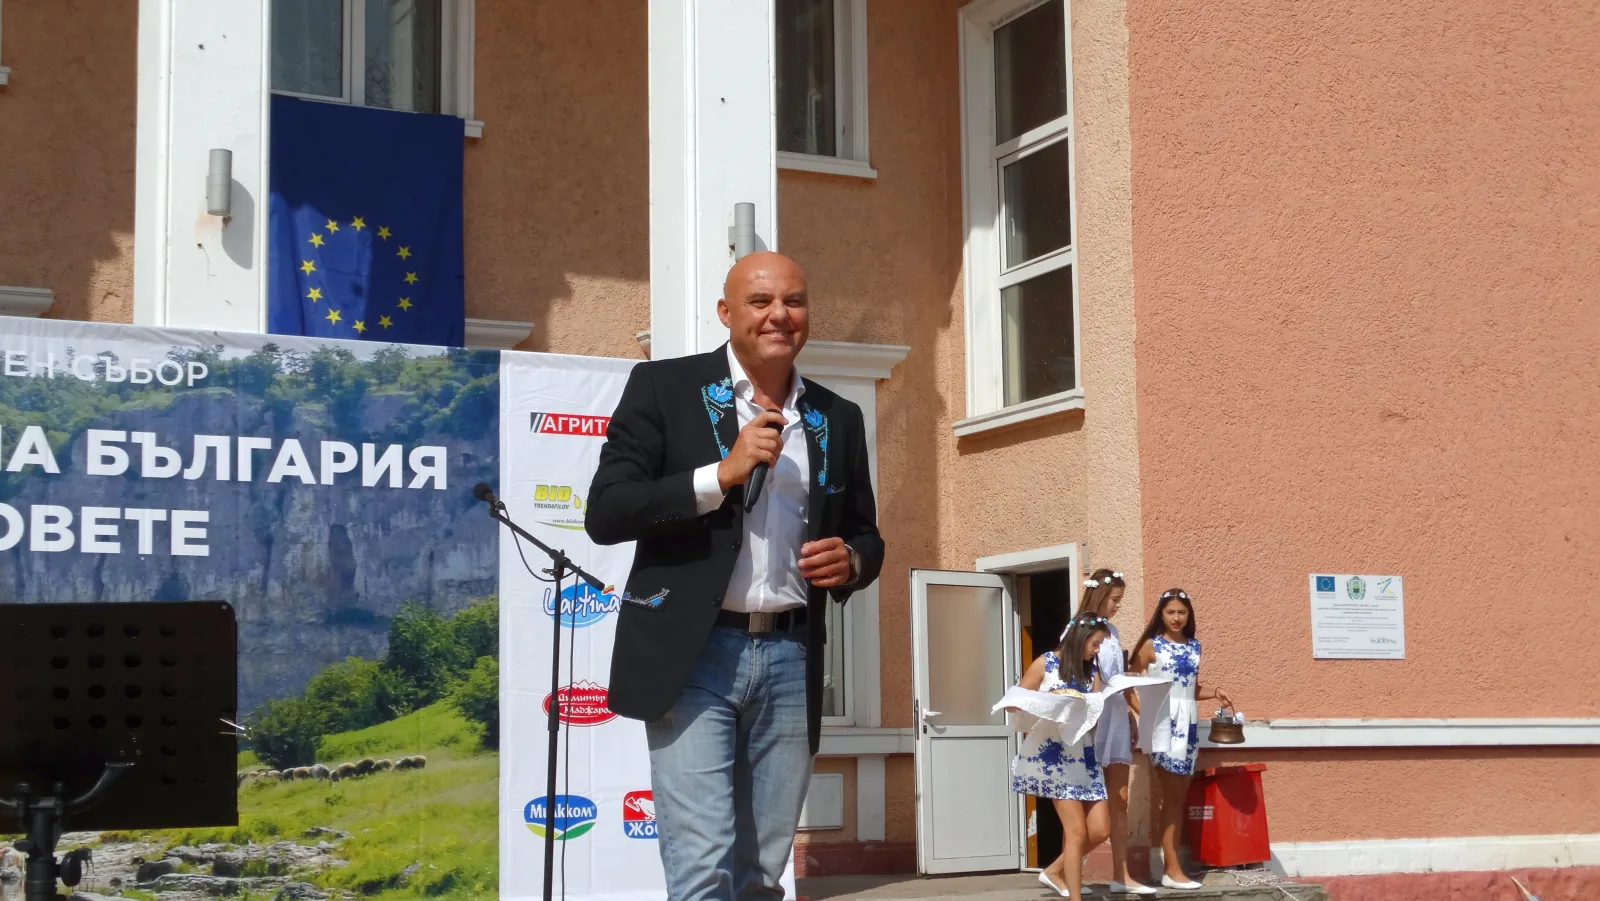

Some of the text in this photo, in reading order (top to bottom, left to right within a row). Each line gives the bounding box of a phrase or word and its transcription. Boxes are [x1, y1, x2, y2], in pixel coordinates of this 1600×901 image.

[4, 349, 209, 387] ЕН СЪБОР
[543, 416, 610, 434] АГРИТ
[0, 425, 448, 490] А БЪЛГАРИЯ
[534, 484, 572, 502] BIO
[543, 584, 622, 618] Lactina
